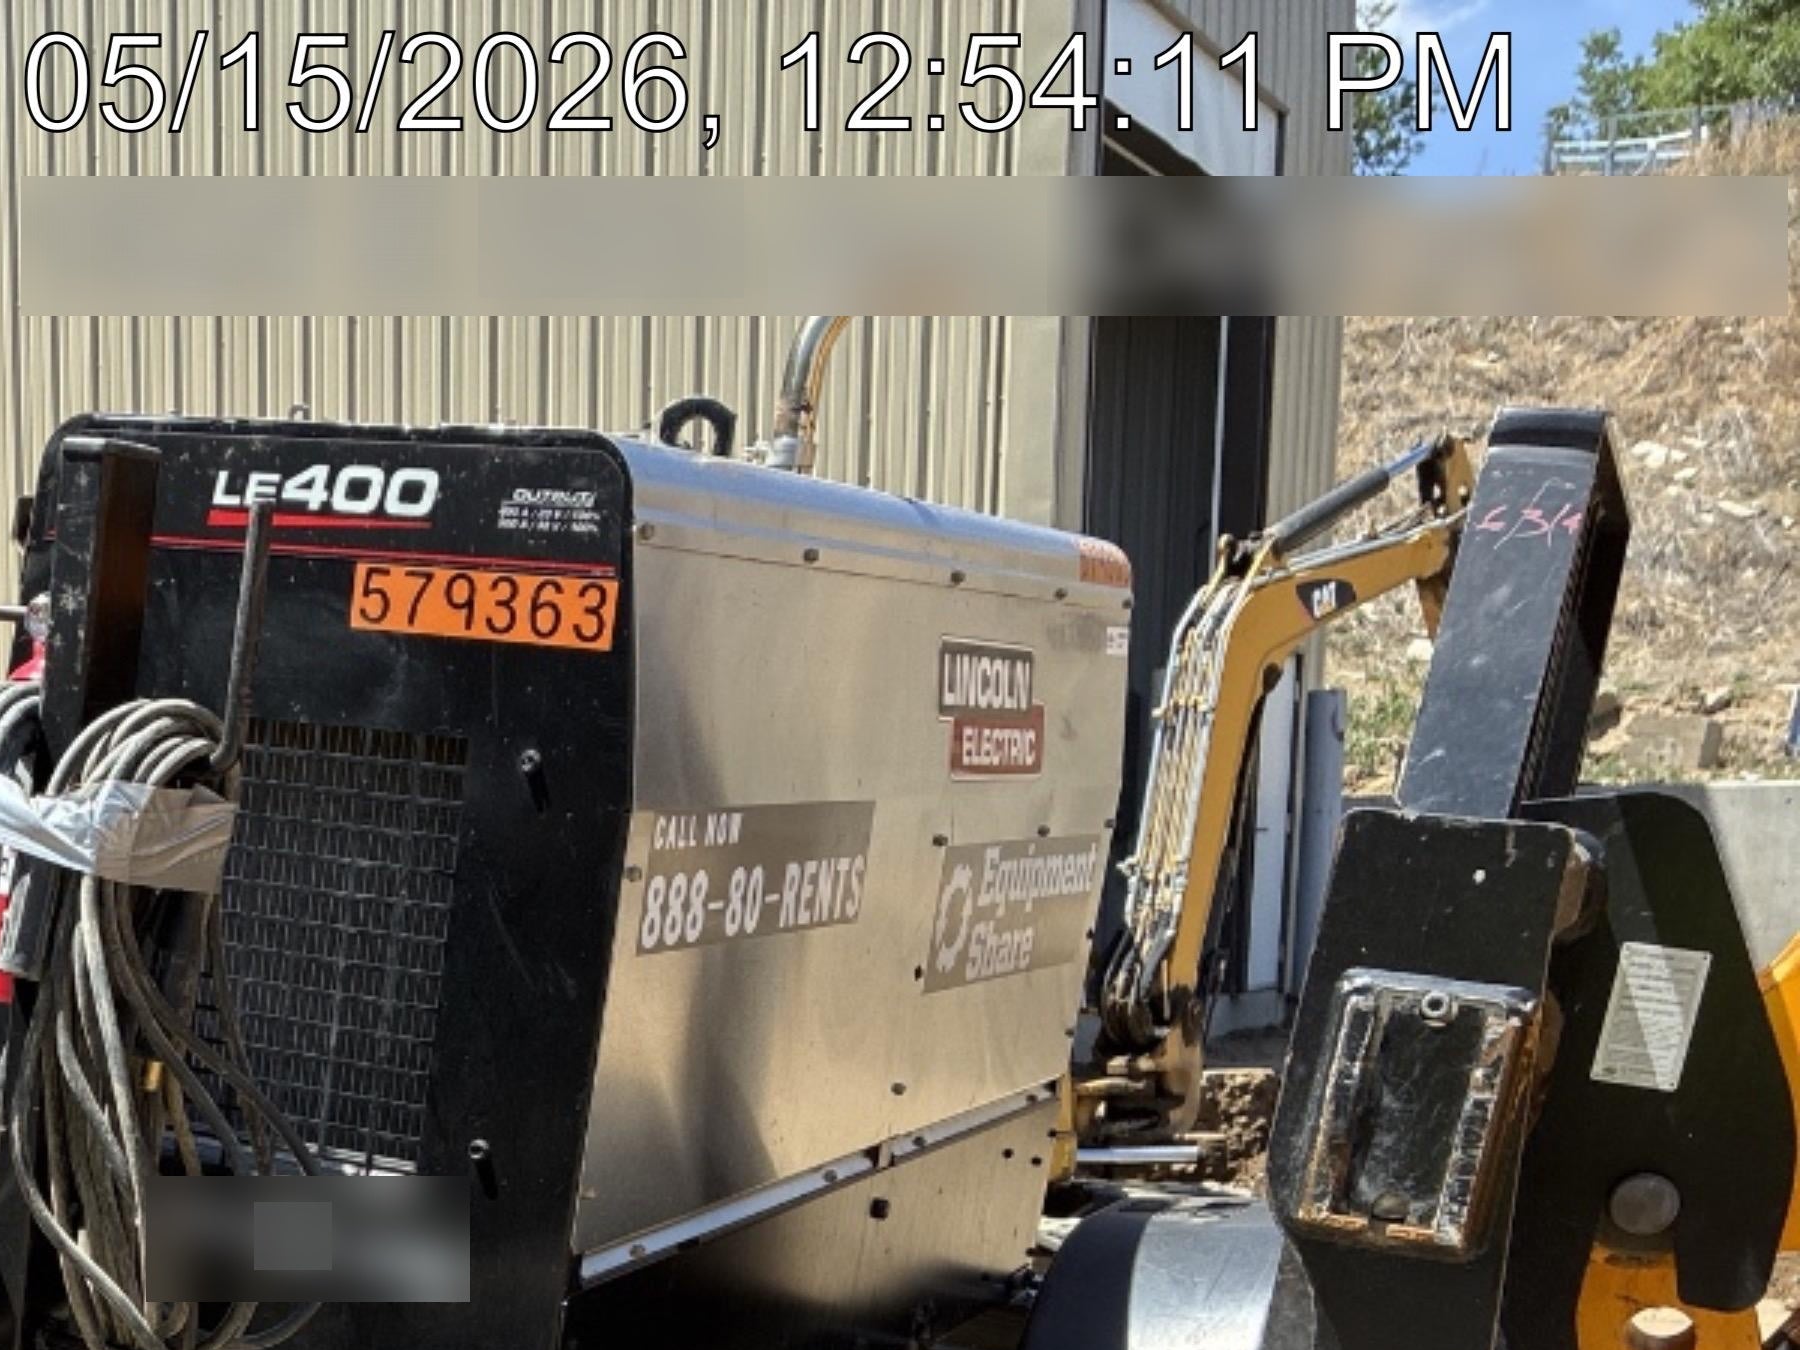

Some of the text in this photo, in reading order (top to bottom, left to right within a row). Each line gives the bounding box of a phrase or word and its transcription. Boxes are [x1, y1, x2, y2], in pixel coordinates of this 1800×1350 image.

[358, 566, 608, 644] 579363
[943, 653, 1031, 711] LINCOLN
[961, 726, 1036, 766] ELECTRIC
[654, 812, 744, 849] CALL NOW
[641, 854, 866, 949] 888-80-RENTS
[977, 845, 1097, 918] Equipment
[965, 921, 1035, 980] Share
